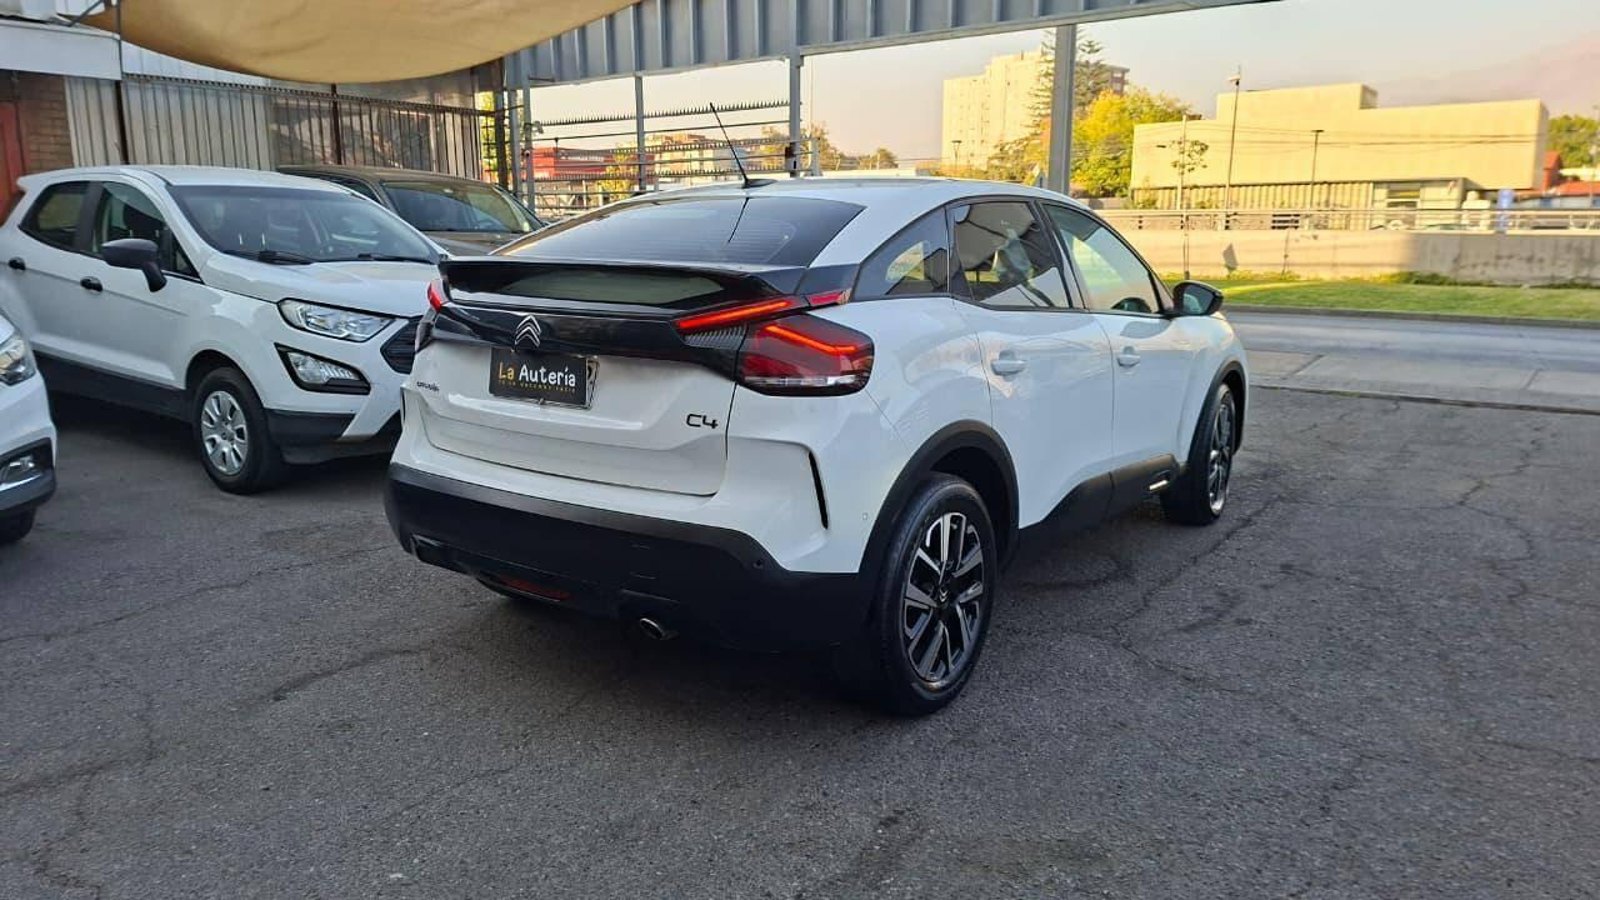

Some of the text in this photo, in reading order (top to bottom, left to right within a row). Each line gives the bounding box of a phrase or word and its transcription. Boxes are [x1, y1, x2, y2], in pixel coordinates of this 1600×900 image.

[499, 361, 515, 380] La
[519, 364, 576, 387] Autería
[686, 413, 719, 429] C4
